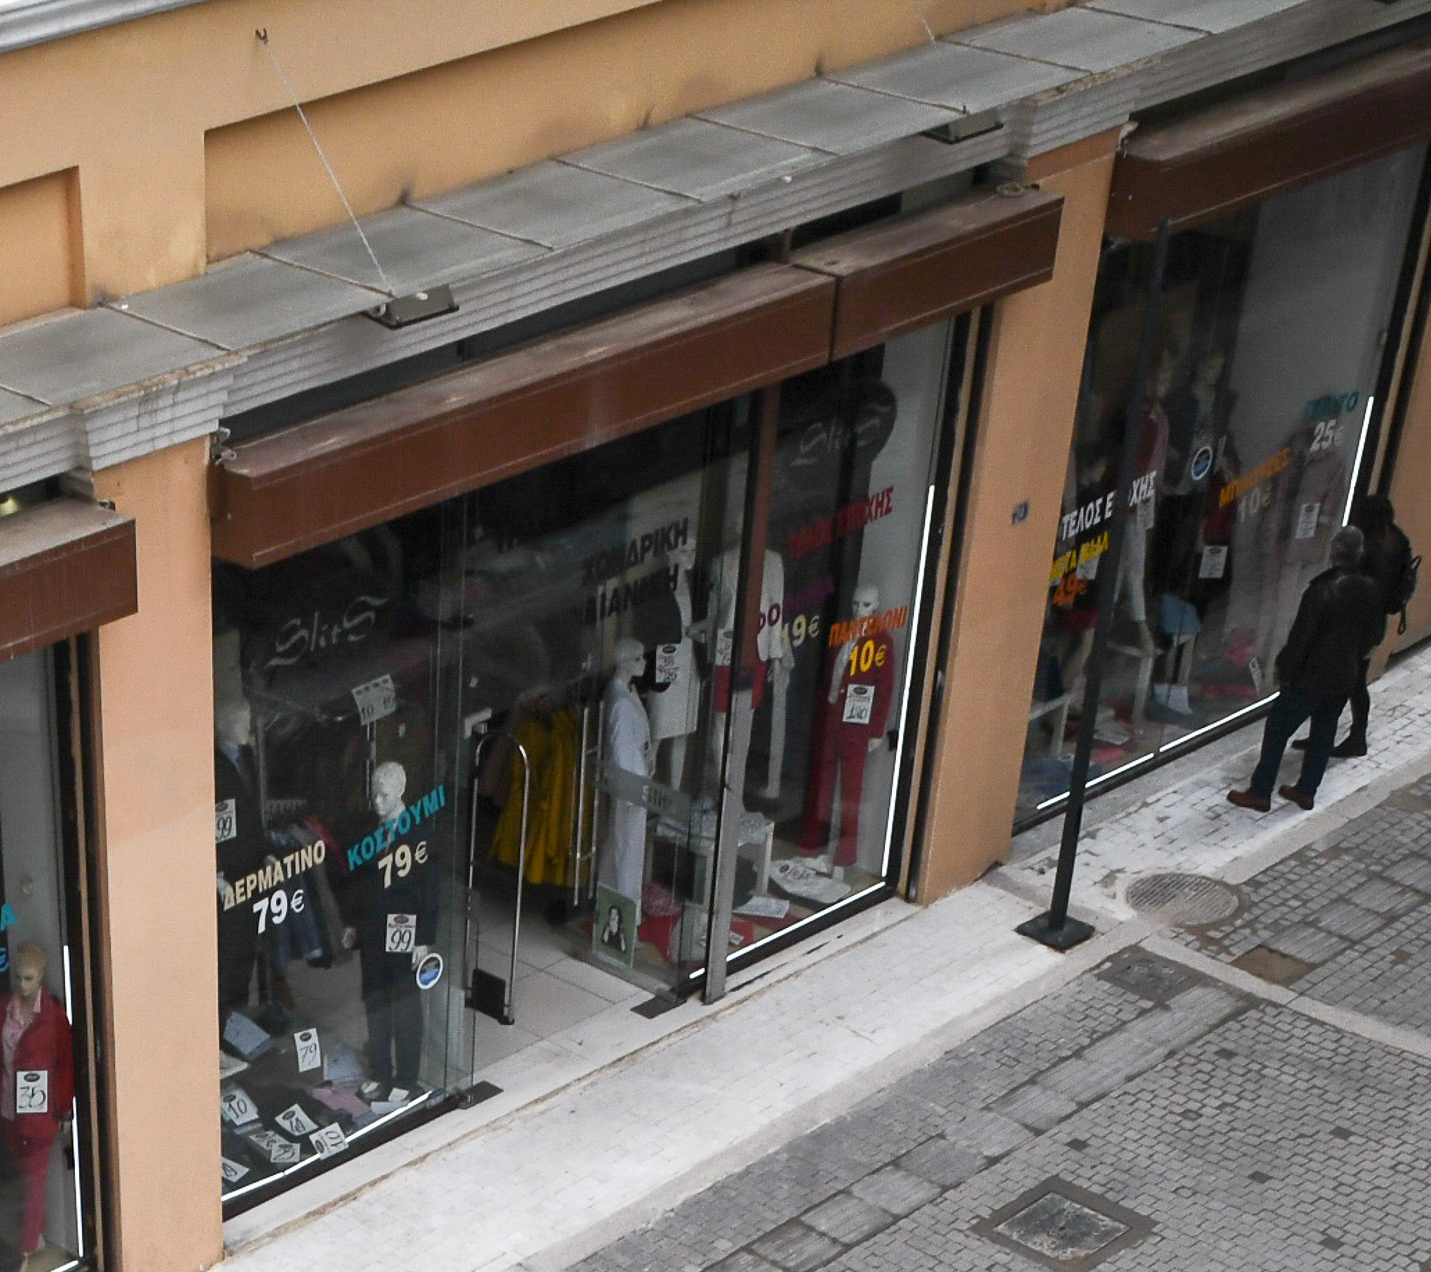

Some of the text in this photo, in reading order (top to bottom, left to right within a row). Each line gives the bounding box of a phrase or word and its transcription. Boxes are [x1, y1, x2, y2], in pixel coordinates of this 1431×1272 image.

[1062, 498, 1104, 541] ΤΕΛΟΣ
[1104, 470, 1157, 520] ΕΧΗΣ
[849, 640, 886, 677] 10€
[346, 783, 446, 872] ΚΟΣΤΟΥΜΙ
[223, 840, 326, 911] ΔΕΡΜΑΤΙΝΟ
[378, 841, 429, 889] 79€
[252, 889, 305, 935] 79€
[388, 929, 413, 951] 99
